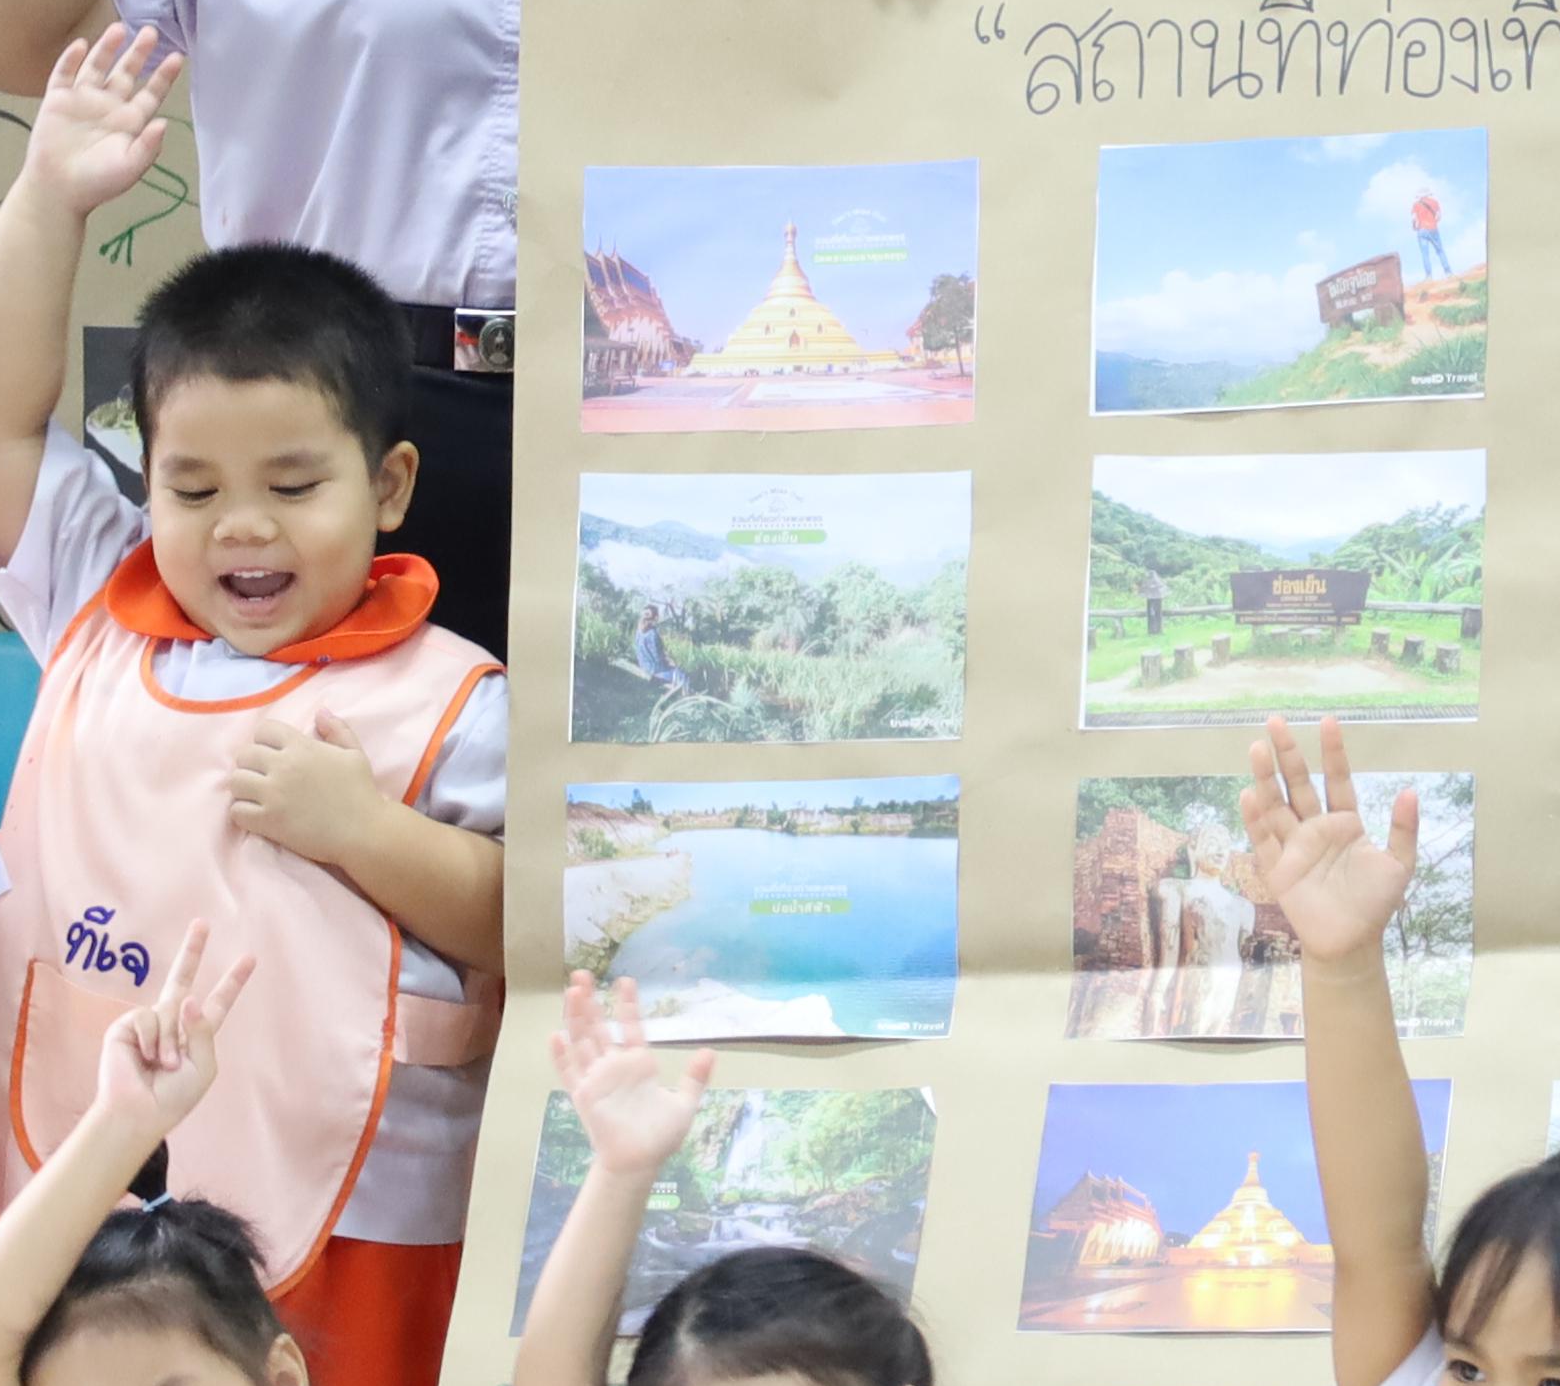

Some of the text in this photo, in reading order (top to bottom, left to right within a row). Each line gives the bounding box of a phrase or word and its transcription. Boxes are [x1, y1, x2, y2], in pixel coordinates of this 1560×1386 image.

[1446, 372, 1479, 384] Travel
[912, 1020, 945, 1031] Travel
[1422, 1017, 1455, 1028] Travel
